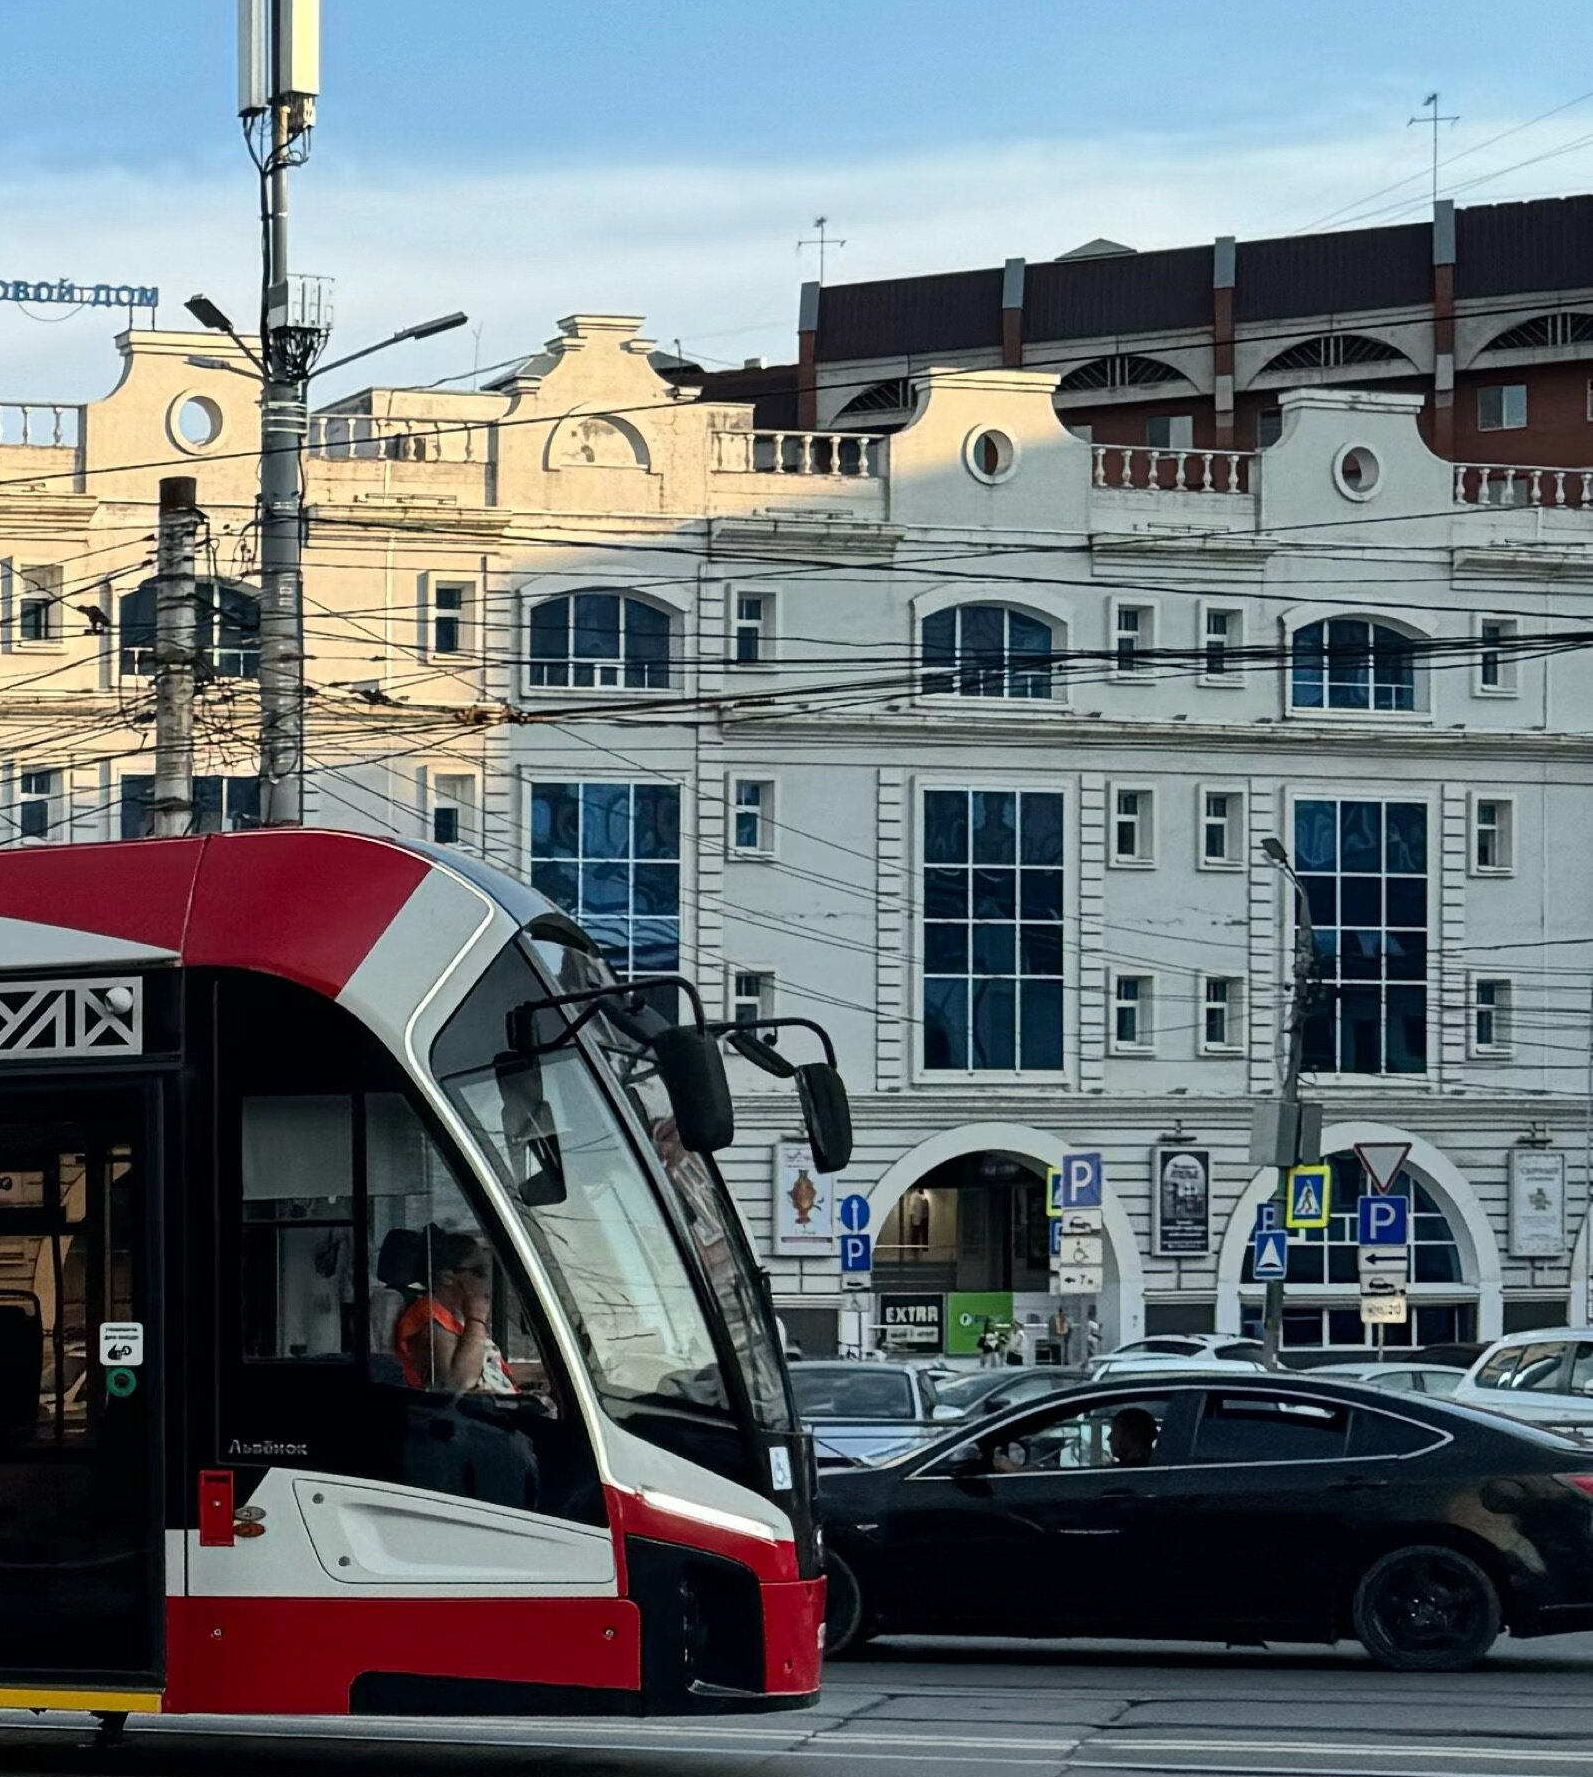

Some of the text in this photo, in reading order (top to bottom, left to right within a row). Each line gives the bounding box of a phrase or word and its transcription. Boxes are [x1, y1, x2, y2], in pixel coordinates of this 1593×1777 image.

[91, 284, 160, 308] ДОМ
[1070, 1159, 1093, 1202] P
[1369, 1202, 1396, 1240] P
[846, 1238, 865, 1268] P
